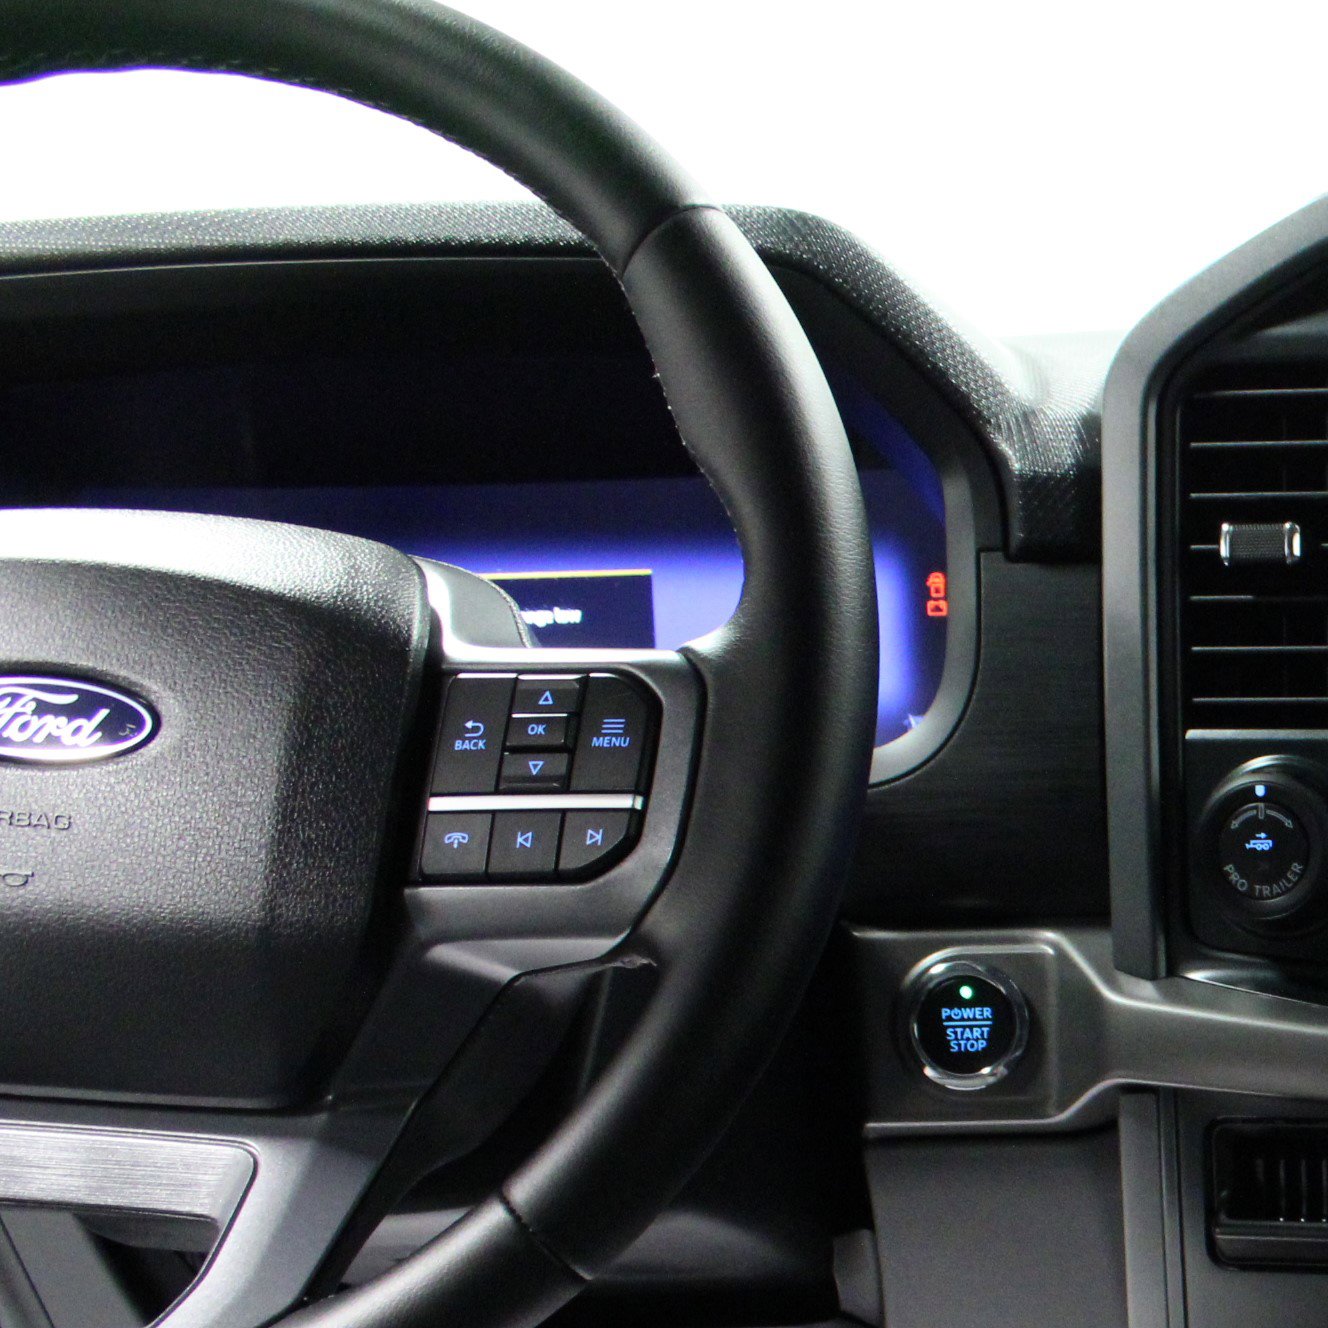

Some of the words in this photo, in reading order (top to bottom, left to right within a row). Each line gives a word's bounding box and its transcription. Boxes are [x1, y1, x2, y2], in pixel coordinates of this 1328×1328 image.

[0, 686, 110, 747] Ford
[527, 723, 546, 735] OK
[454, 738, 486, 752] BACK
[591, 735, 630, 749] MENU
[1223, 864, 1249, 891] PRO
[1253, 862, 1304, 897] TRAILER
[941, 1007, 992, 1020] POWER
[946, 1027, 990, 1040] START
[950, 1040, 987, 1052] STOP
